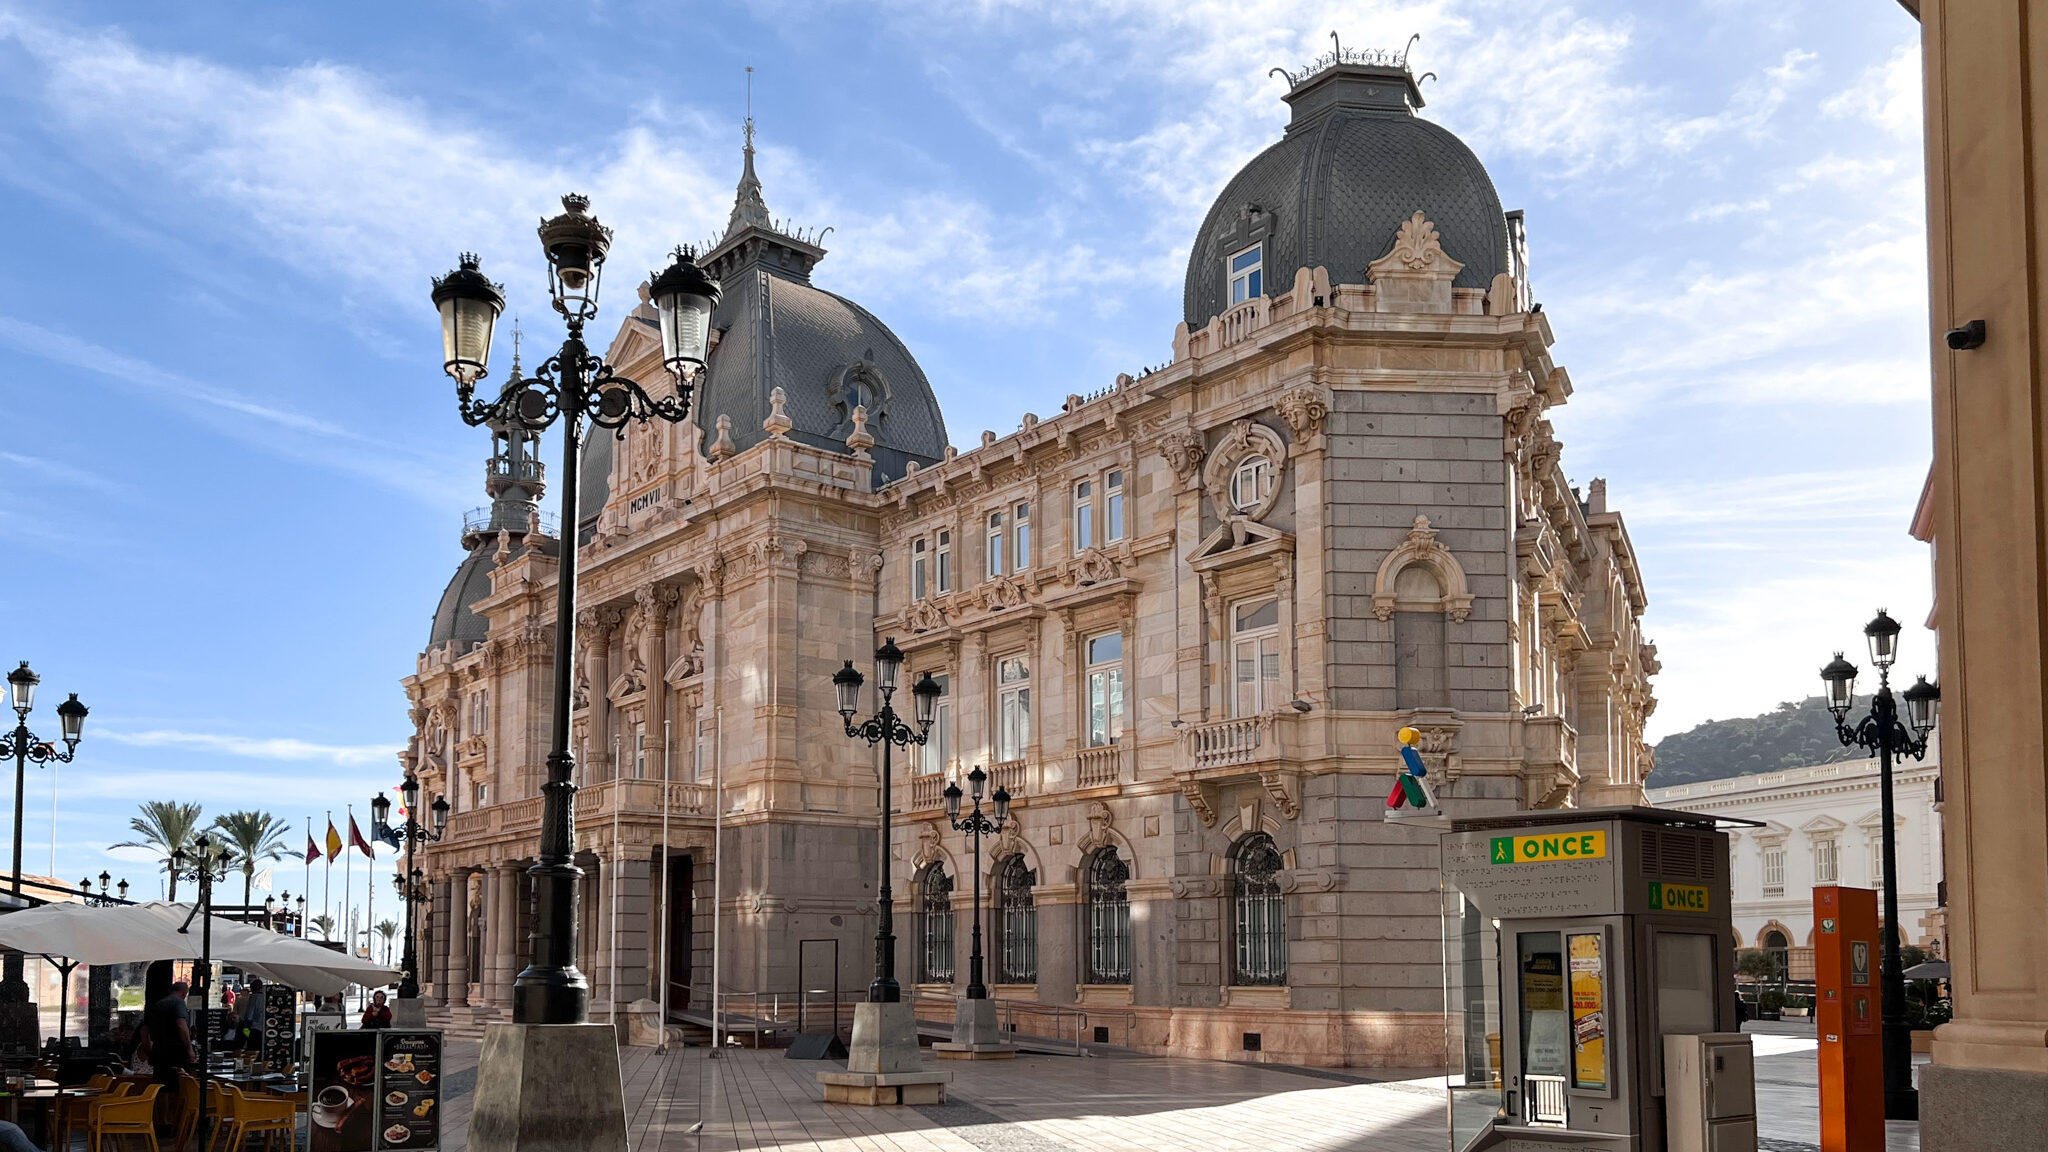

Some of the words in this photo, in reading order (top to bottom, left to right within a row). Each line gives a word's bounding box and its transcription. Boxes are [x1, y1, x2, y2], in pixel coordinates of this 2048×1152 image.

[631, 487, 661, 515] MCMVII
[1523, 835, 1595, 858] ONCE
[1666, 887, 1705, 909] ONCE
